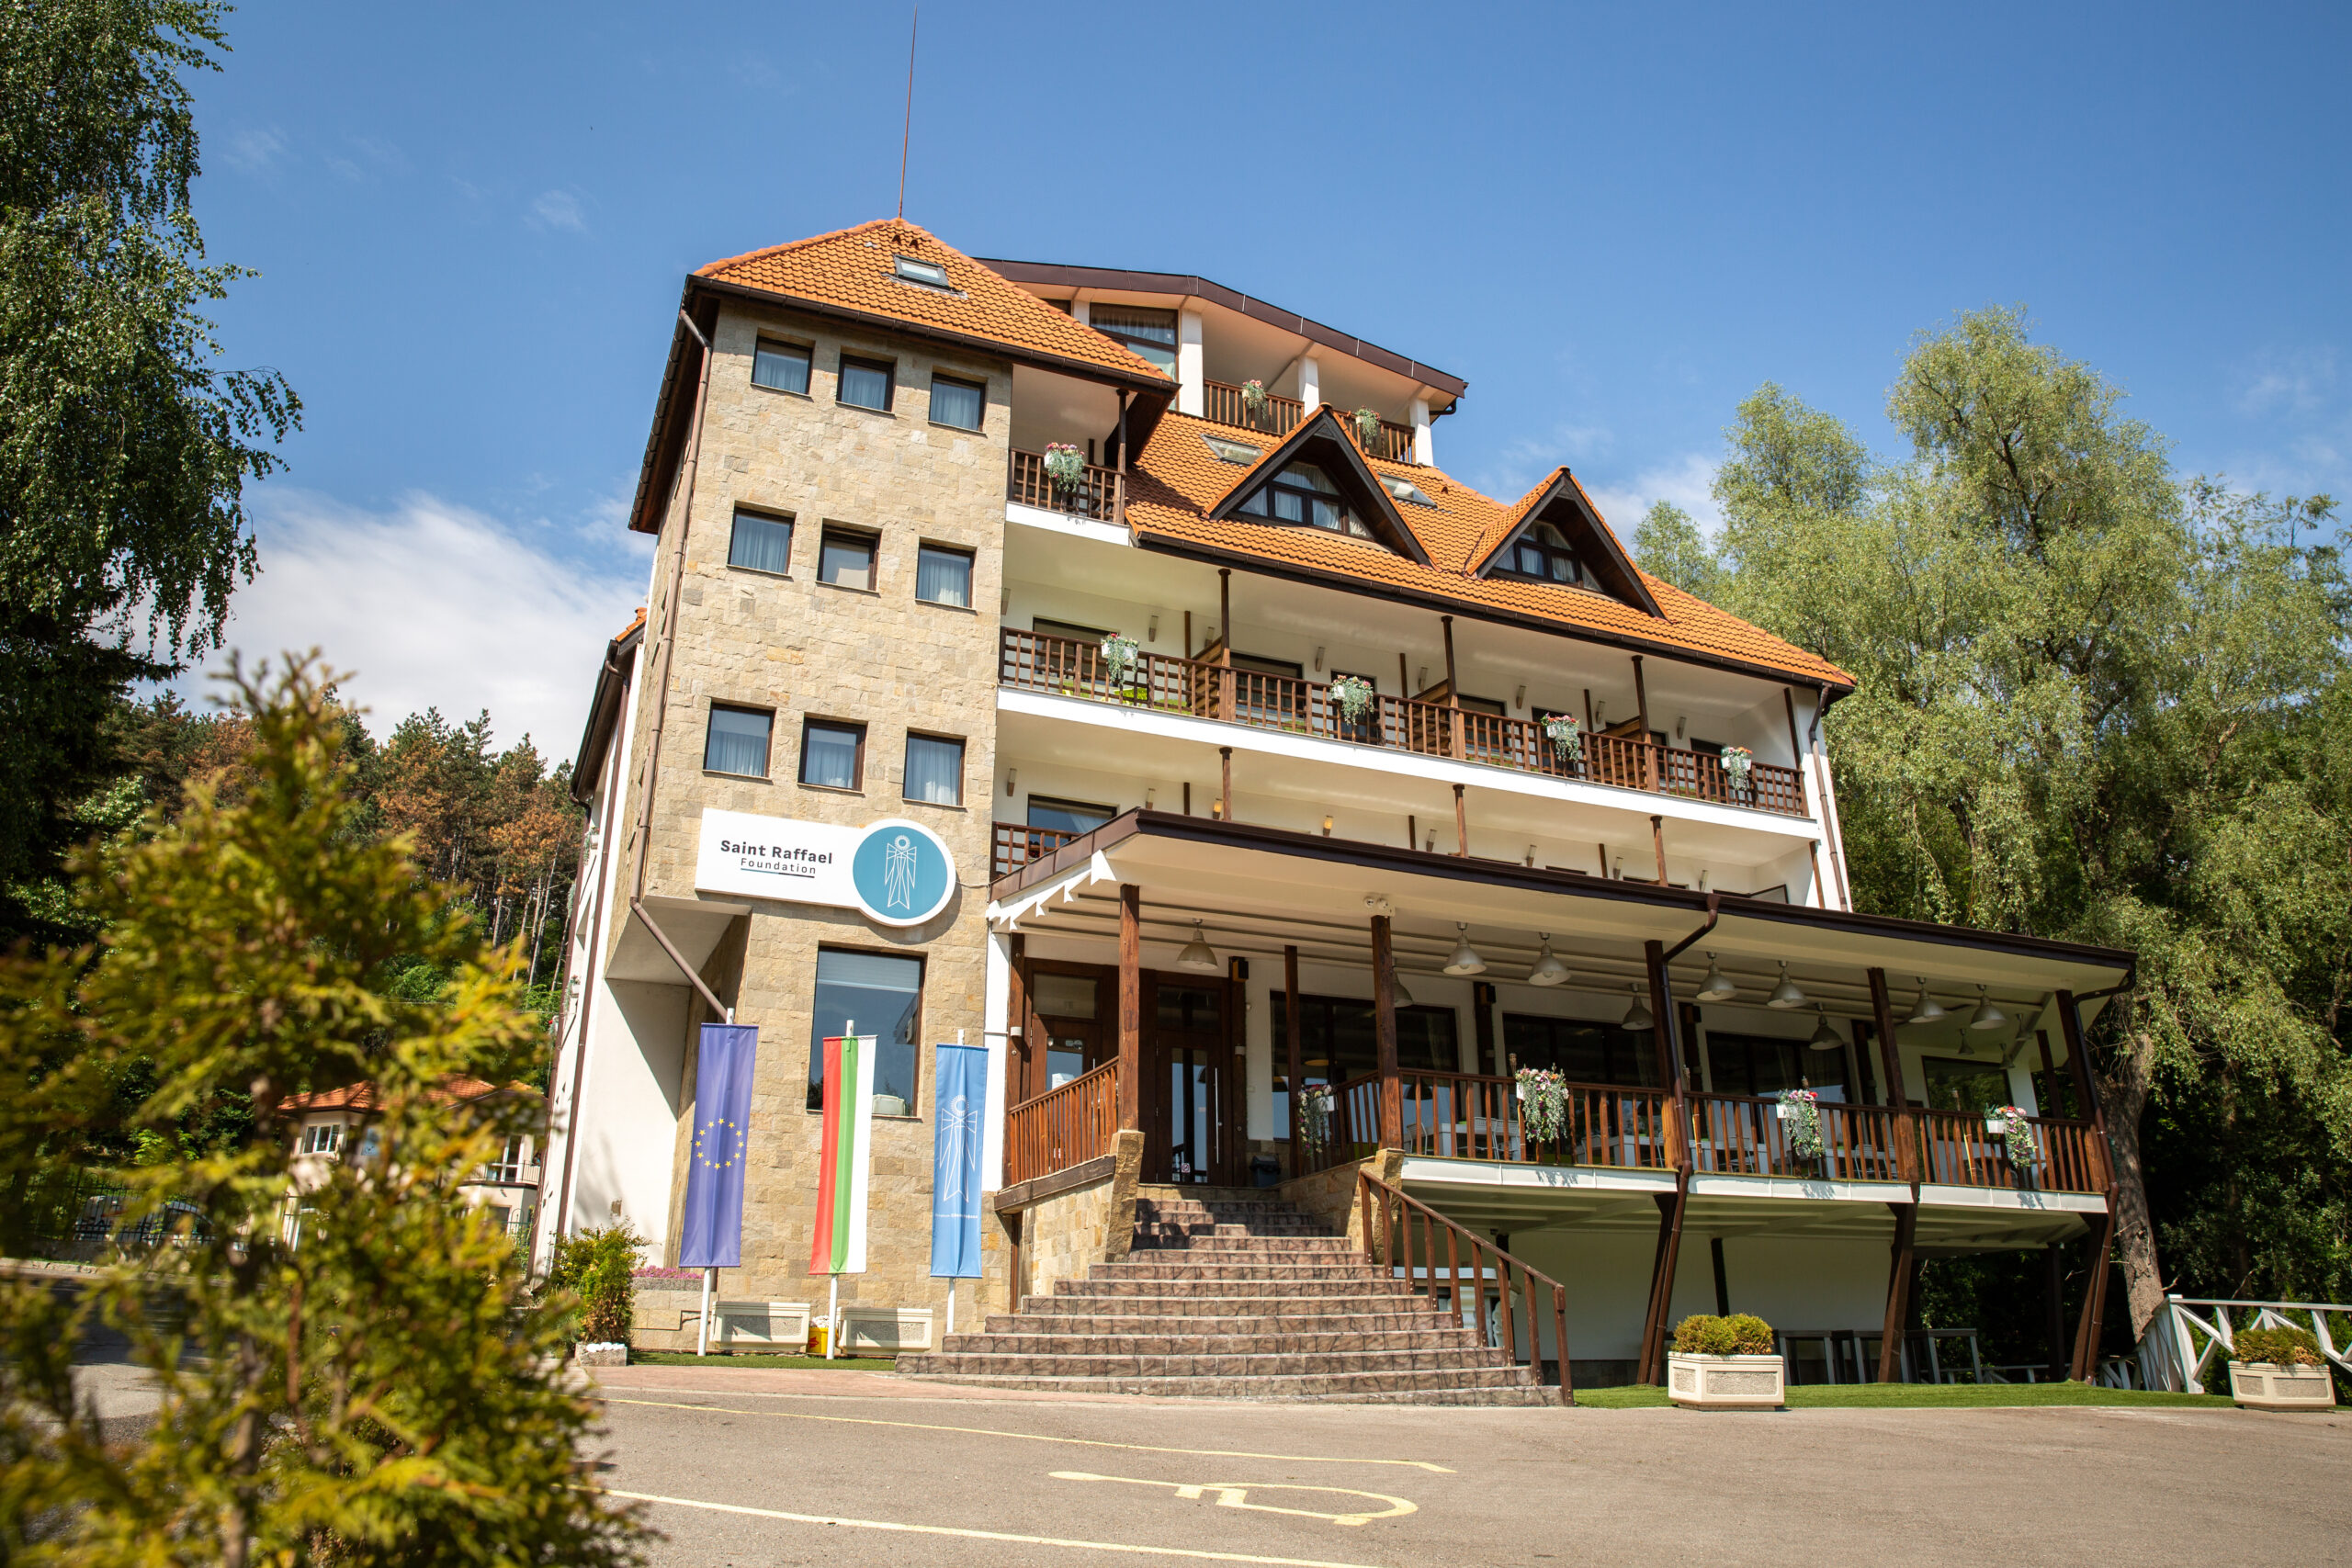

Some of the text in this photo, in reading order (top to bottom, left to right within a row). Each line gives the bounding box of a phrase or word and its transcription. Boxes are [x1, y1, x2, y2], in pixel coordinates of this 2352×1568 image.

[720, 840, 832, 863] Saint Raffael
[741, 858, 816, 874] Foundation
